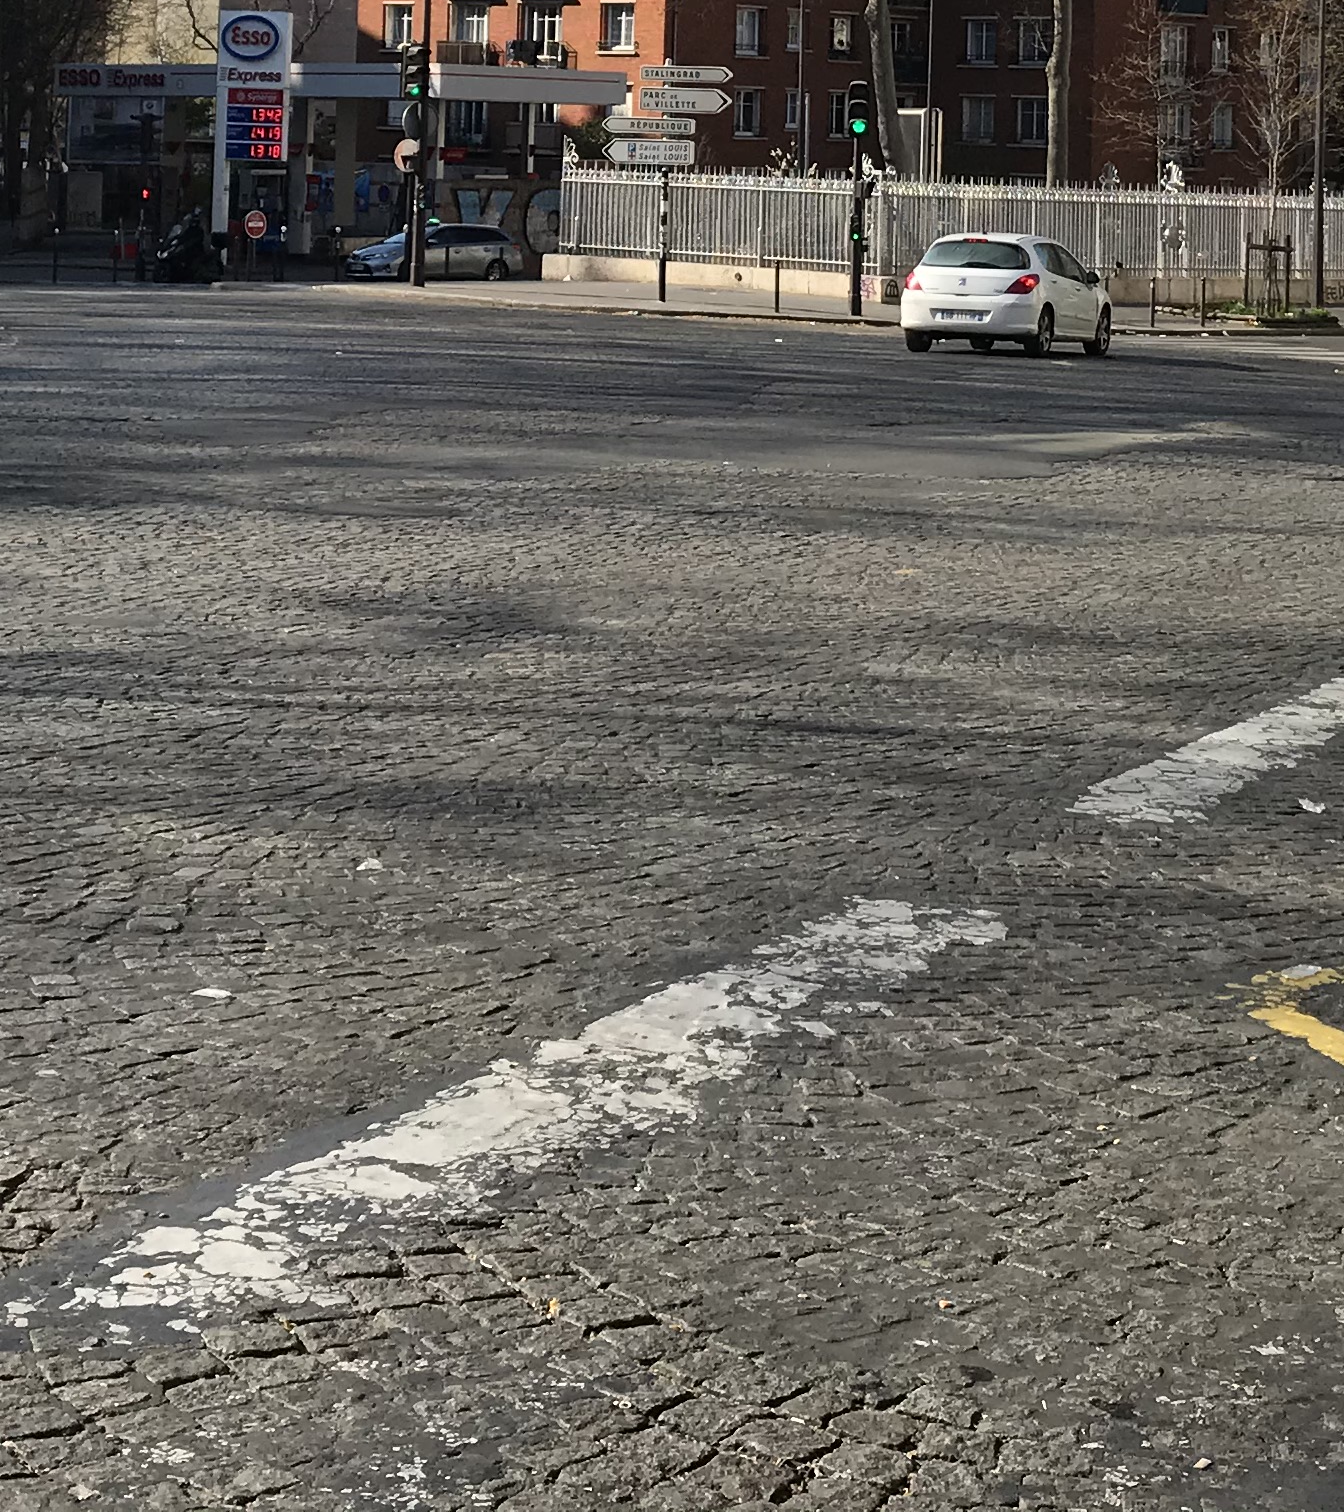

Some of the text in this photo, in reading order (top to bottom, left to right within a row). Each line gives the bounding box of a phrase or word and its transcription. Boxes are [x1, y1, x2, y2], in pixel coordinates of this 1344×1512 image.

[231, 26, 271, 46] Esso
[227, 68, 282, 84] Express
[644, 70, 701, 79] STALINGRAD
[59, 69, 165, 90] ESSO Express
[643, 91, 666, 99] PARC
[654, 101, 697, 109] VILLETTE
[630, 120, 689, 131] RÉPUBLIQUE
[639, 144, 661, 152] Saint
[663, 144, 688, 153] LOUIS
[663, 153, 688, 161] LOUIS
